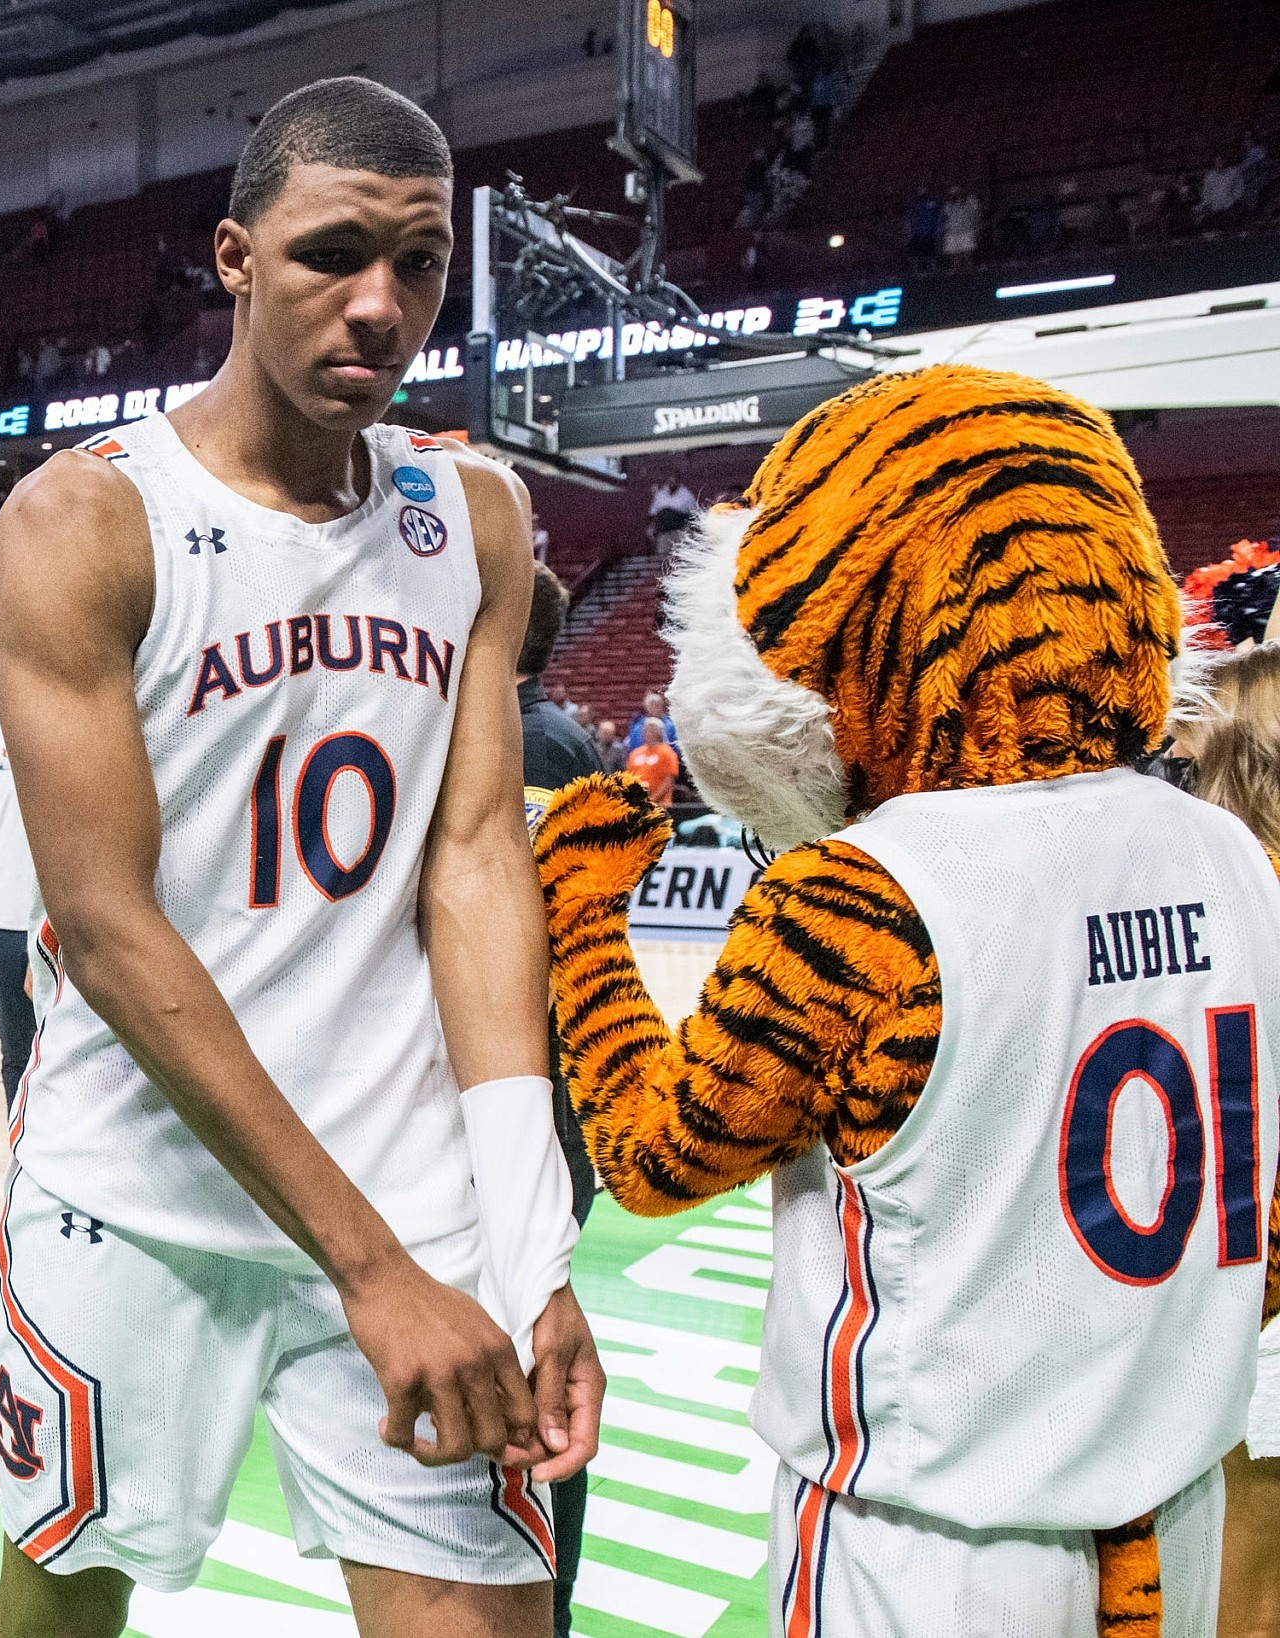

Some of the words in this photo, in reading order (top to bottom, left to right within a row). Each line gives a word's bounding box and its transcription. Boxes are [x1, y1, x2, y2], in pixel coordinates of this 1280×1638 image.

[44, 394, 119, 430] 2022
[402, 346, 464, 383] ALL
[495, 306, 774, 372] HAMPIONSHIP
[653, 396, 761, 434] SPALDING
[401, 508, 445, 552] SEC
[187, 614, 456, 717] AUBURN
[249, 730, 397, 908] 10
[637, 865, 732, 910] ERN
[1086, 902, 1211, 986] AUBIE
[1058, 1003, 1262, 1288] 01
